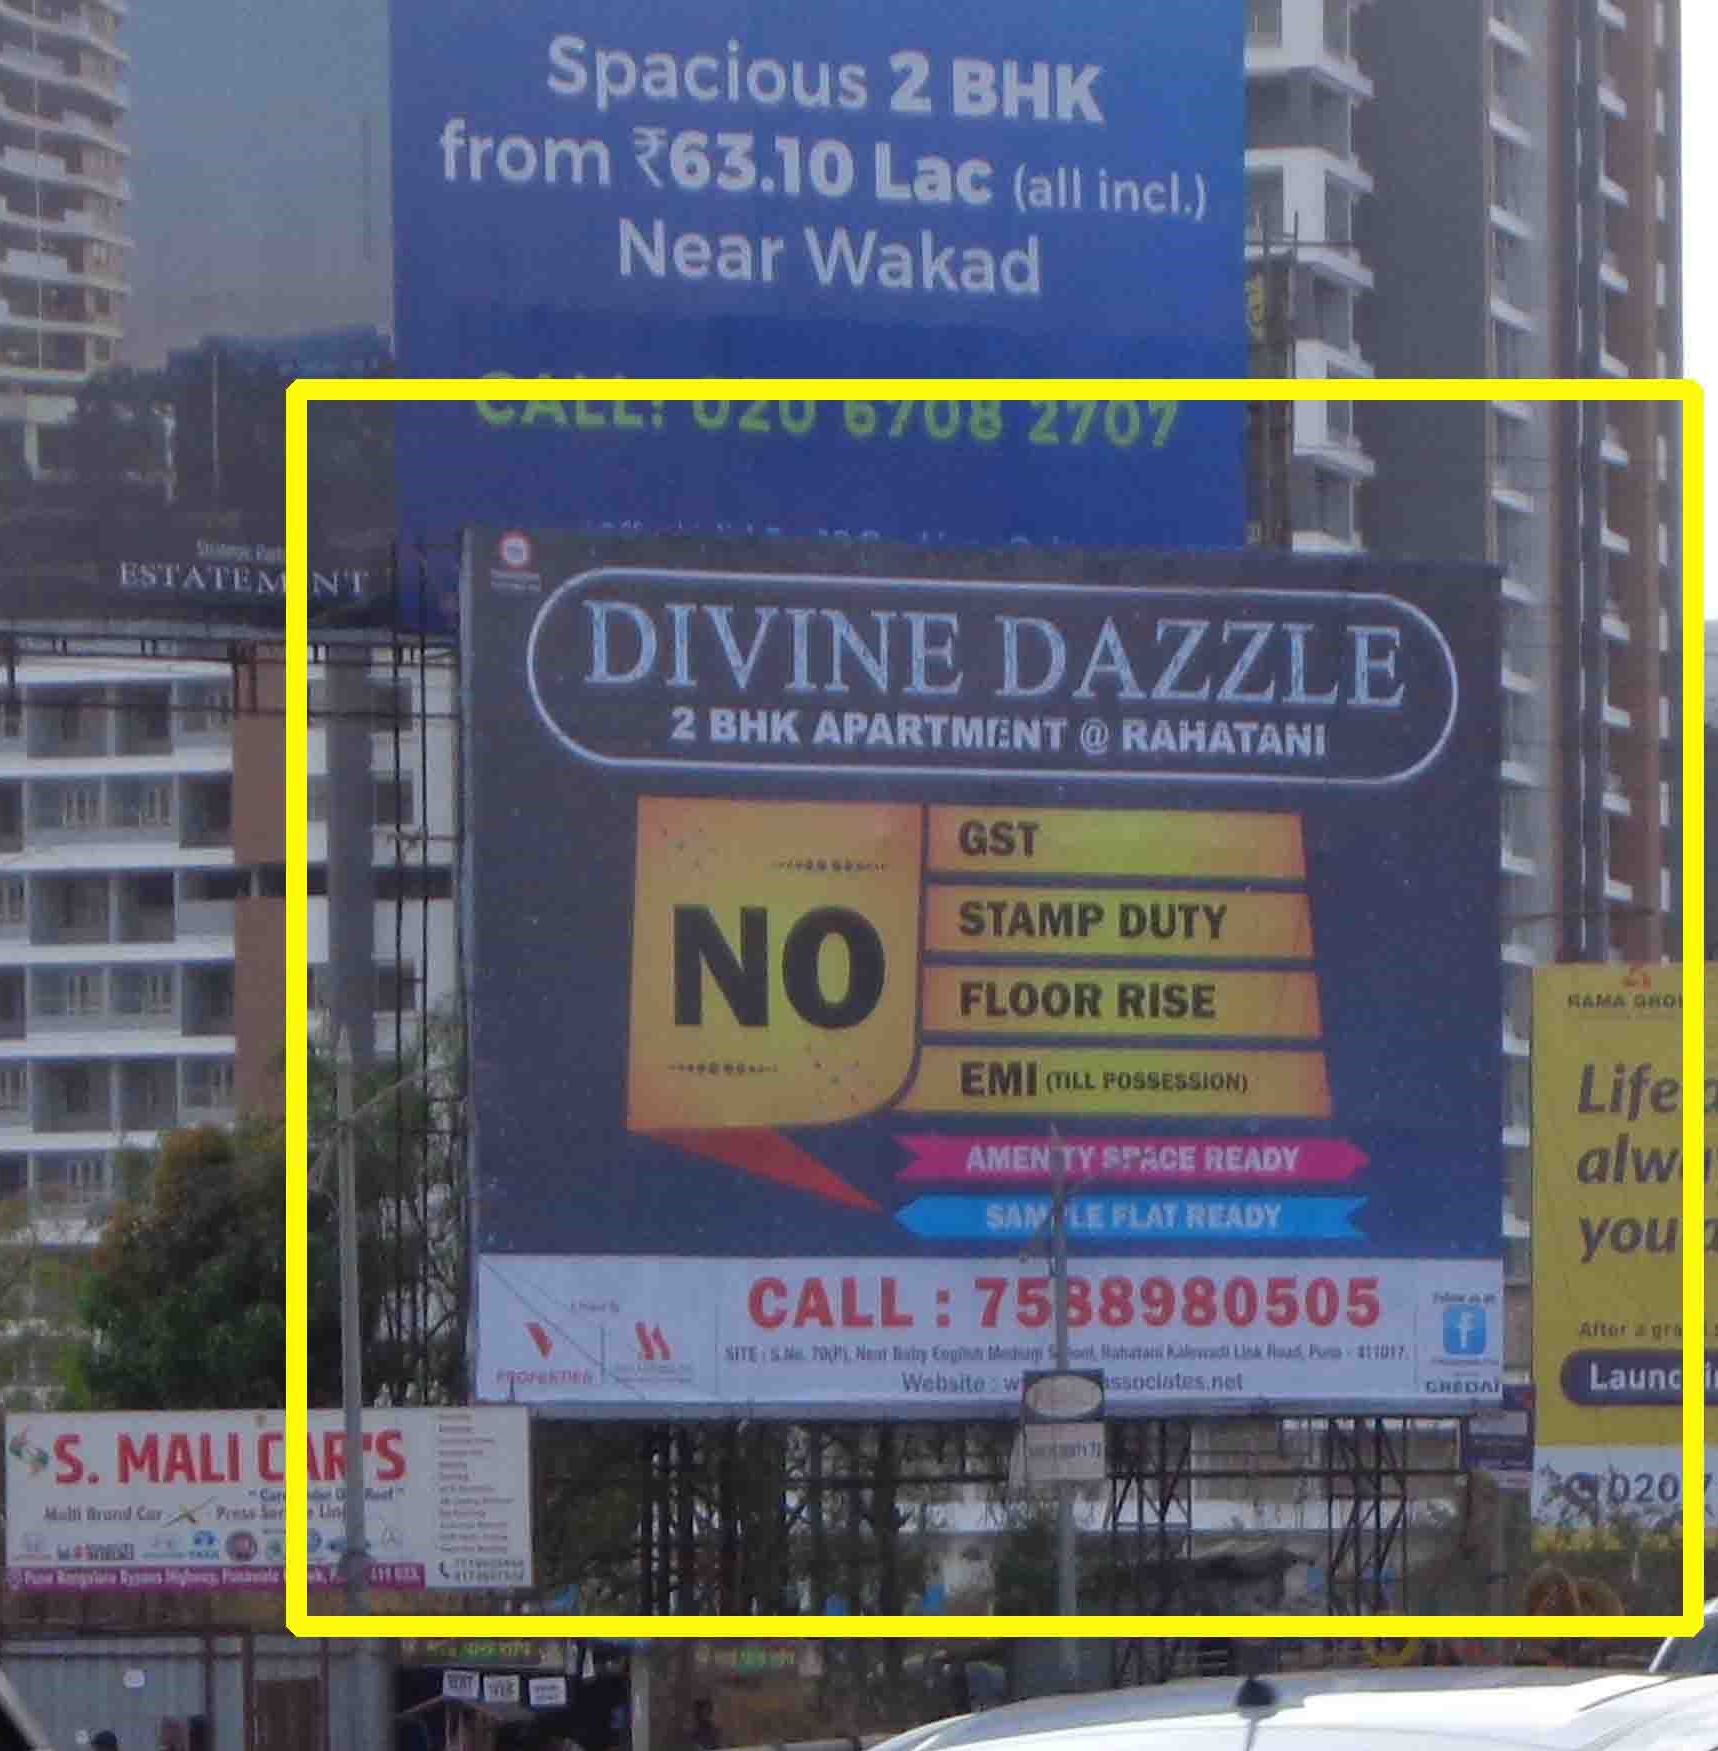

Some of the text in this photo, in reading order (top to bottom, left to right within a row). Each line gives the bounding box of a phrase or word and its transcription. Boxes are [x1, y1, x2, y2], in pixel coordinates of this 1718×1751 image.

[546, 34, 1106, 124] Spacious 2 BHK
[440, 119, 1208, 220] from ₹63.10 Lac (all incl.)
[618, 218, 1043, 295] Near Wakad
[477, 372, 667, 430] CALL:
[691, 376, 818, 434] 020
[119, 561, 371, 595] ESTATEMNT
[584, 599, 1405, 707] DIVINE DAZZLE
[671, 708, 1326, 756] 2 BHK APARTMENT @ RAHATANI
[960, 821, 1039, 857] GST
[959, 902, 1228, 939] STAMP DUTY
[673, 903, 887, 1030] NO
[960, 981, 1216, 1018] FLOOR RISE
[960, 1062, 1249, 1097] EMI (TILL POSSESSION)
[1578, 1063, 1679, 1121] Life
[966, 1146, 1299, 1173] AMENTY SPACE READY
[986, 1203, 1282, 1232] SAMLE FLAT READY
[1578, 1216, 1679, 1264] you
[747, 1275, 915, 1329] CALL
[974, 1274, 1380, 1329] 7588980505
[902, 1371, 985, 1393] Website
[54, 1433, 100, 1485] S.
[117, 1431, 240, 1485] MALI
[1608, 1472, 1679, 1502] 020
